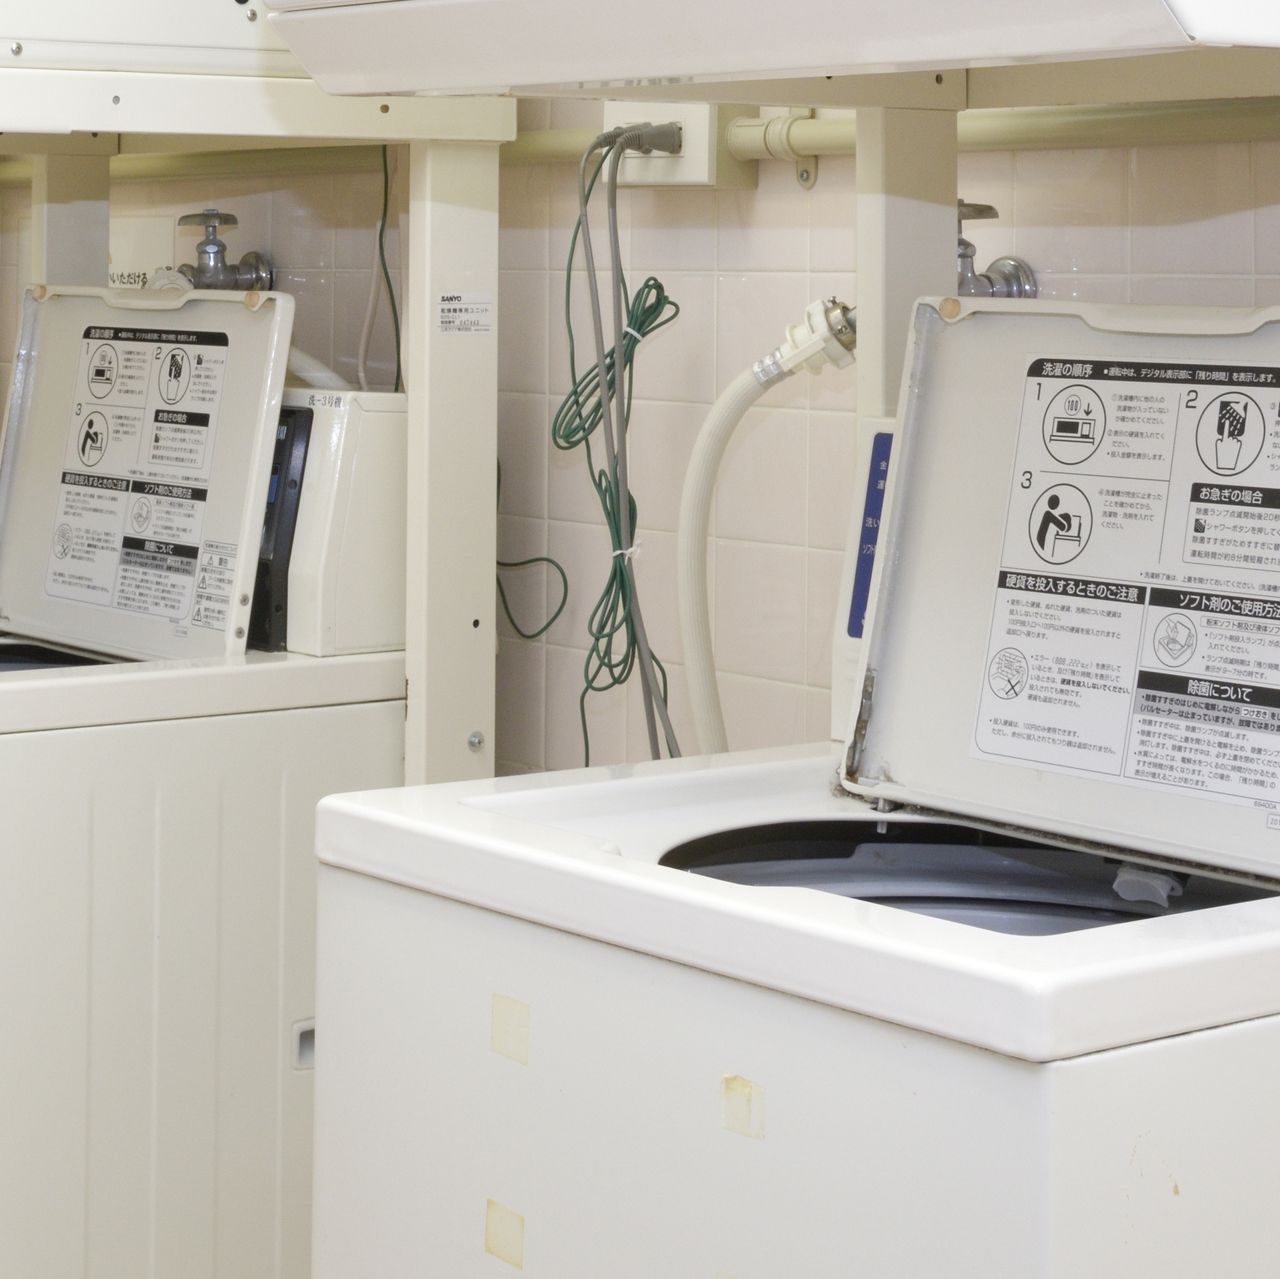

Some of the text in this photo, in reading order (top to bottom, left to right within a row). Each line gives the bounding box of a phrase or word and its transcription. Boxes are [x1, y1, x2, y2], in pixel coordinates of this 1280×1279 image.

[1041, 362, 1093, 377] 洗濯の順序
[1034, 382, 1042, 400] 1
[1184, 389, 1199, 408] 2
[1020, 470, 1033, 489] 3
[1198, 486, 1263, 504] お急ぎの場合
[1005, 573, 1139, 602] 硬貨を投入するときのご注意
[1186, 679, 1253, 702] 除菌について
